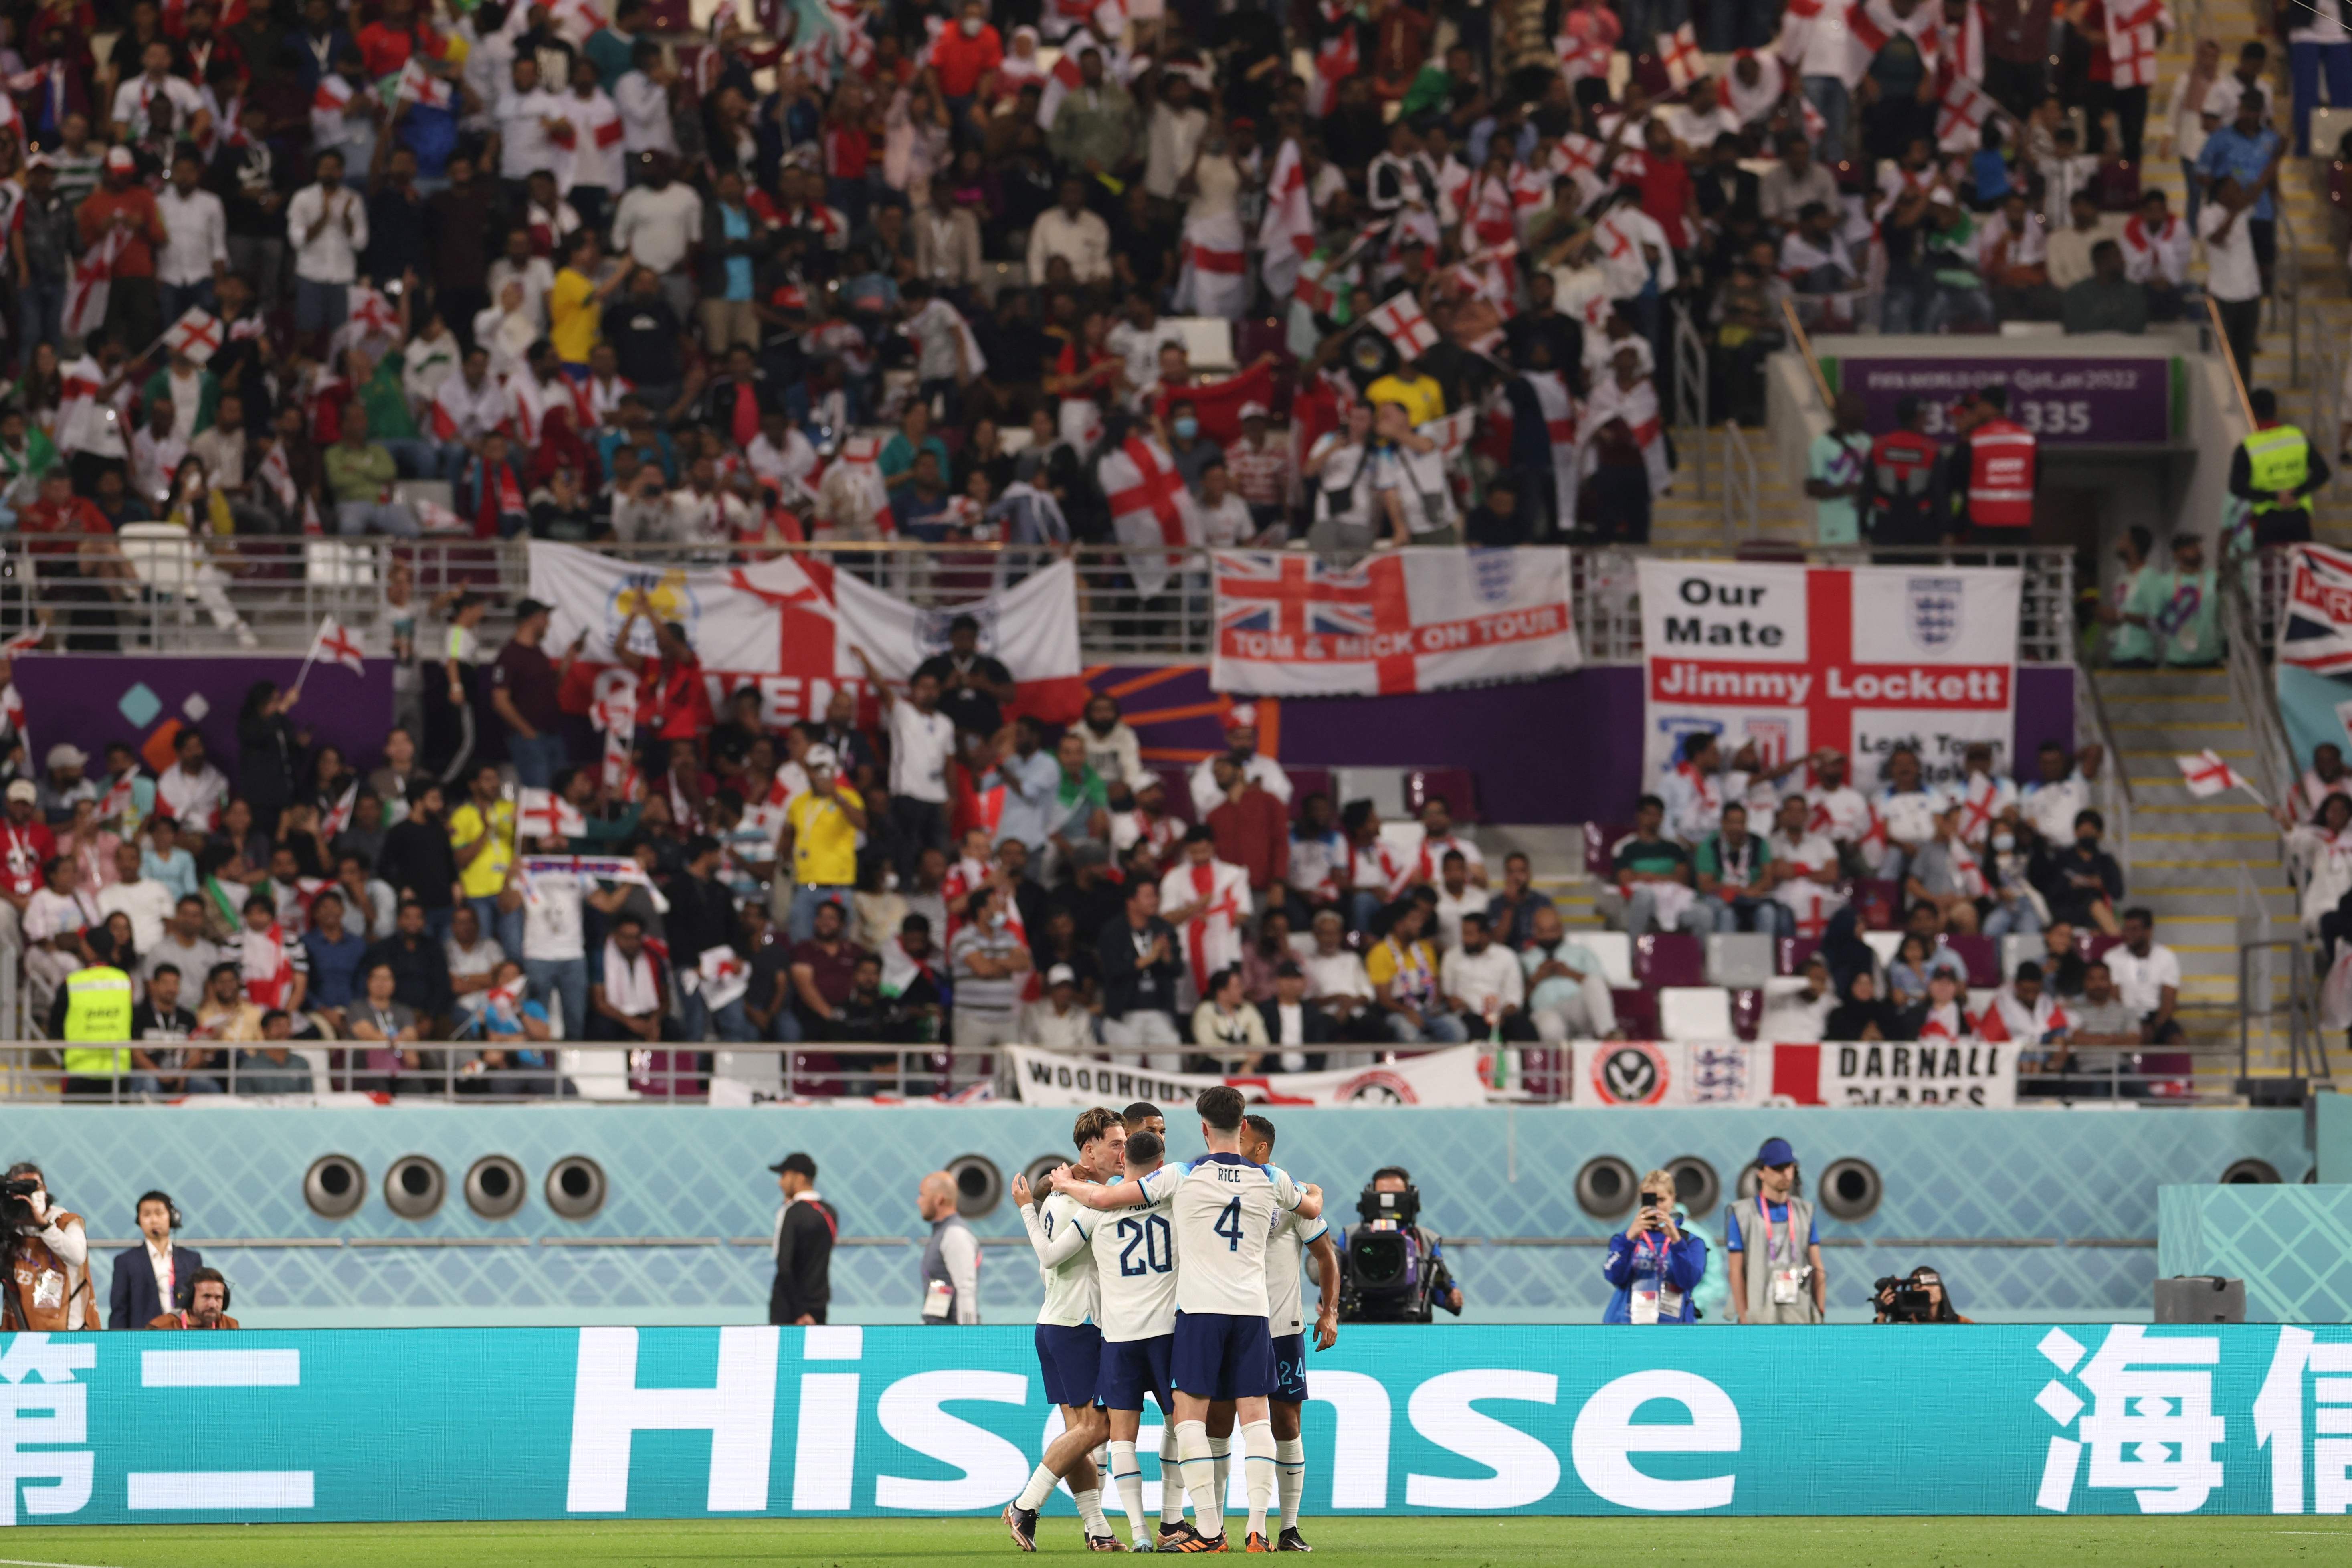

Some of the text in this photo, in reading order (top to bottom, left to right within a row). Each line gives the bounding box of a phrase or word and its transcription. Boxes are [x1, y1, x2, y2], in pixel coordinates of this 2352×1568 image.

[1679, 578, 1767, 605] Our
[1233, 606, 1559, 659] TOM & MICK ON TOUR
[1664, 617, 1784, 647] Mate
[1659, 665, 2001, 704] Jimmy Lockett
[1028, 1059, 1207, 1101] WOODHOUS
[1839, 1047, 1998, 1078] DARNALL
[1218, 1168, 1241, 1183] RICE
[1214, 1196, 1244, 1251] 4
[1117, 1213, 1173, 1277] 20
[1279, 1356, 1305, 1385] 24
